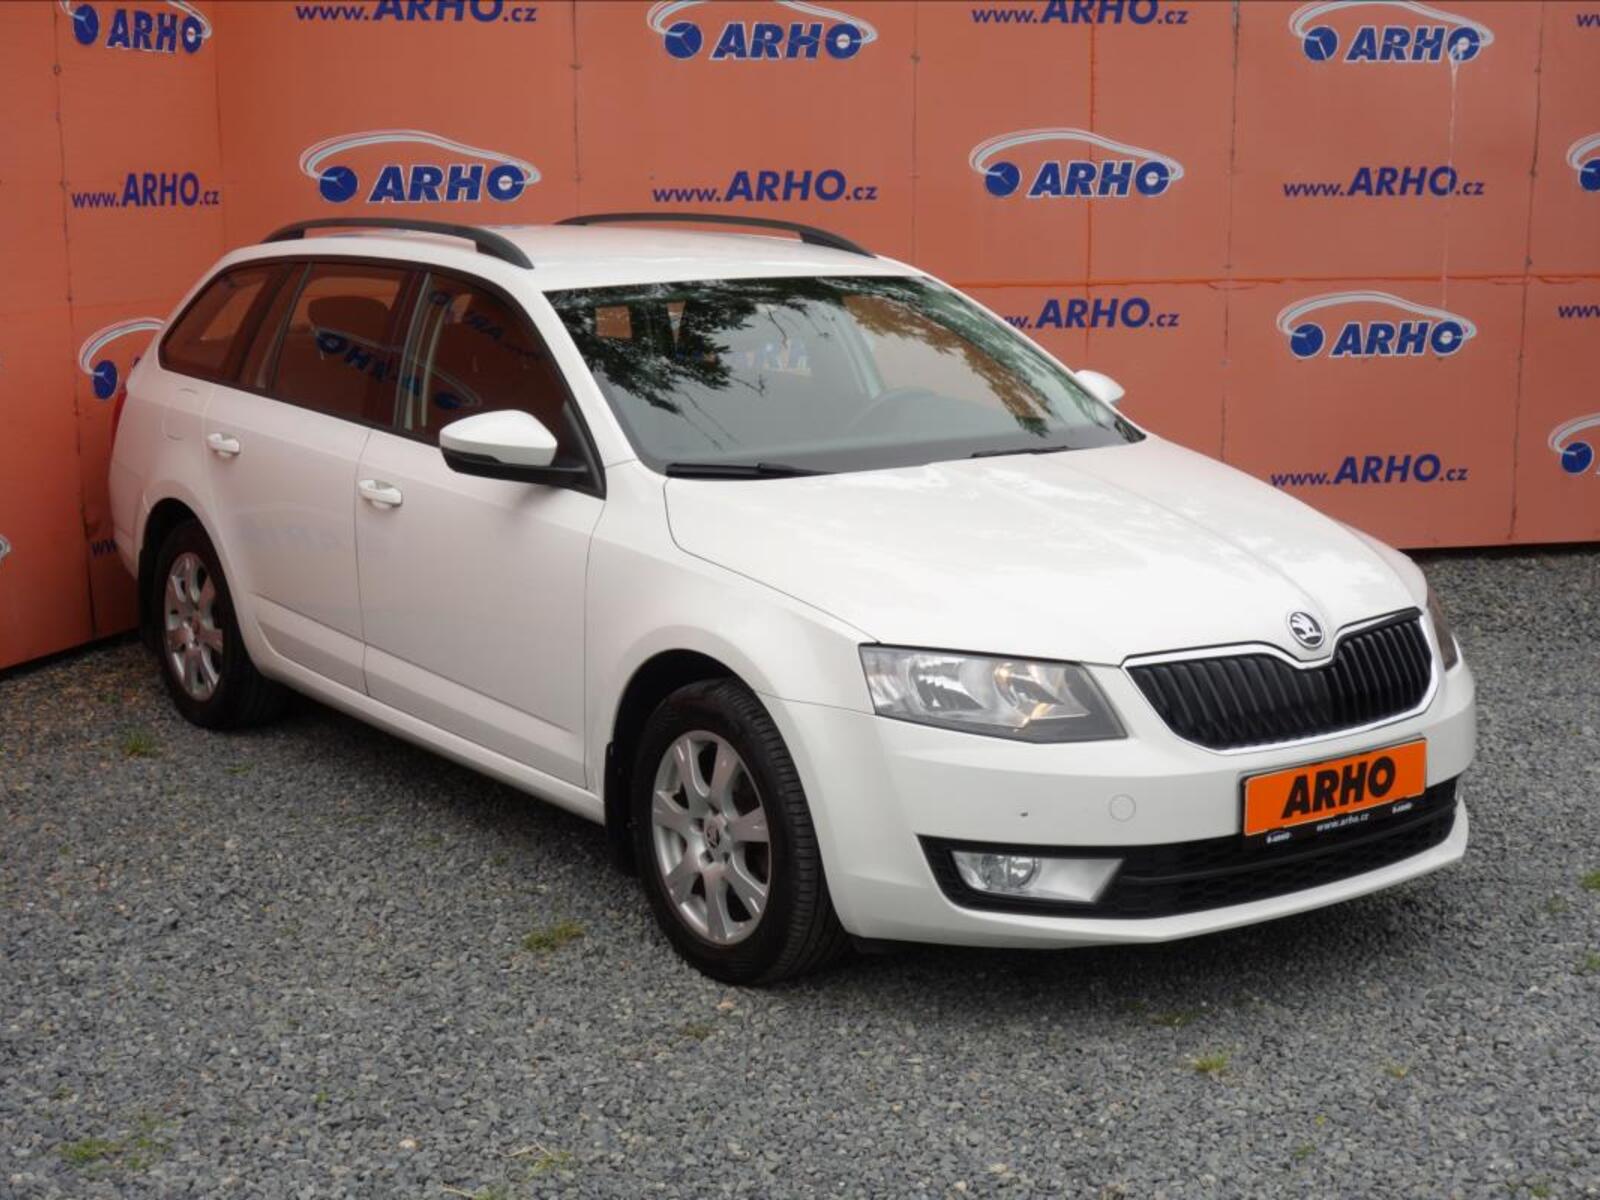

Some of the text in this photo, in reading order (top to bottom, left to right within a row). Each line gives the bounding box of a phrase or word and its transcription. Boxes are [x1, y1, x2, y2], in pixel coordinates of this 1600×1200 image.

[296, 0, 537, 23] www.ARHO.cz
[972, 0, 1188, 25] www.ARHO.cz
[106, 8, 205, 55] ARHO
[711, 21, 864, 61] ARHO
[1345, 25, 1482, 63] ARHO
[72, 171, 220, 208] www.ARHO.cz
[367, 163, 526, 204] ARHO
[652, 169, 878, 203] www.ARHO.cz
[1027, 159, 1172, 199] ARHO
[1283, 165, 1485, 198] www.ARHO.cz
[1003, 297, 1180, 330] w.ARHO.cz
[1329, 320, 1466, 358] ARHO
[1270, 453, 1469, 487] www.ARHO.cz
[1280, 755, 1396, 820] ARHO
